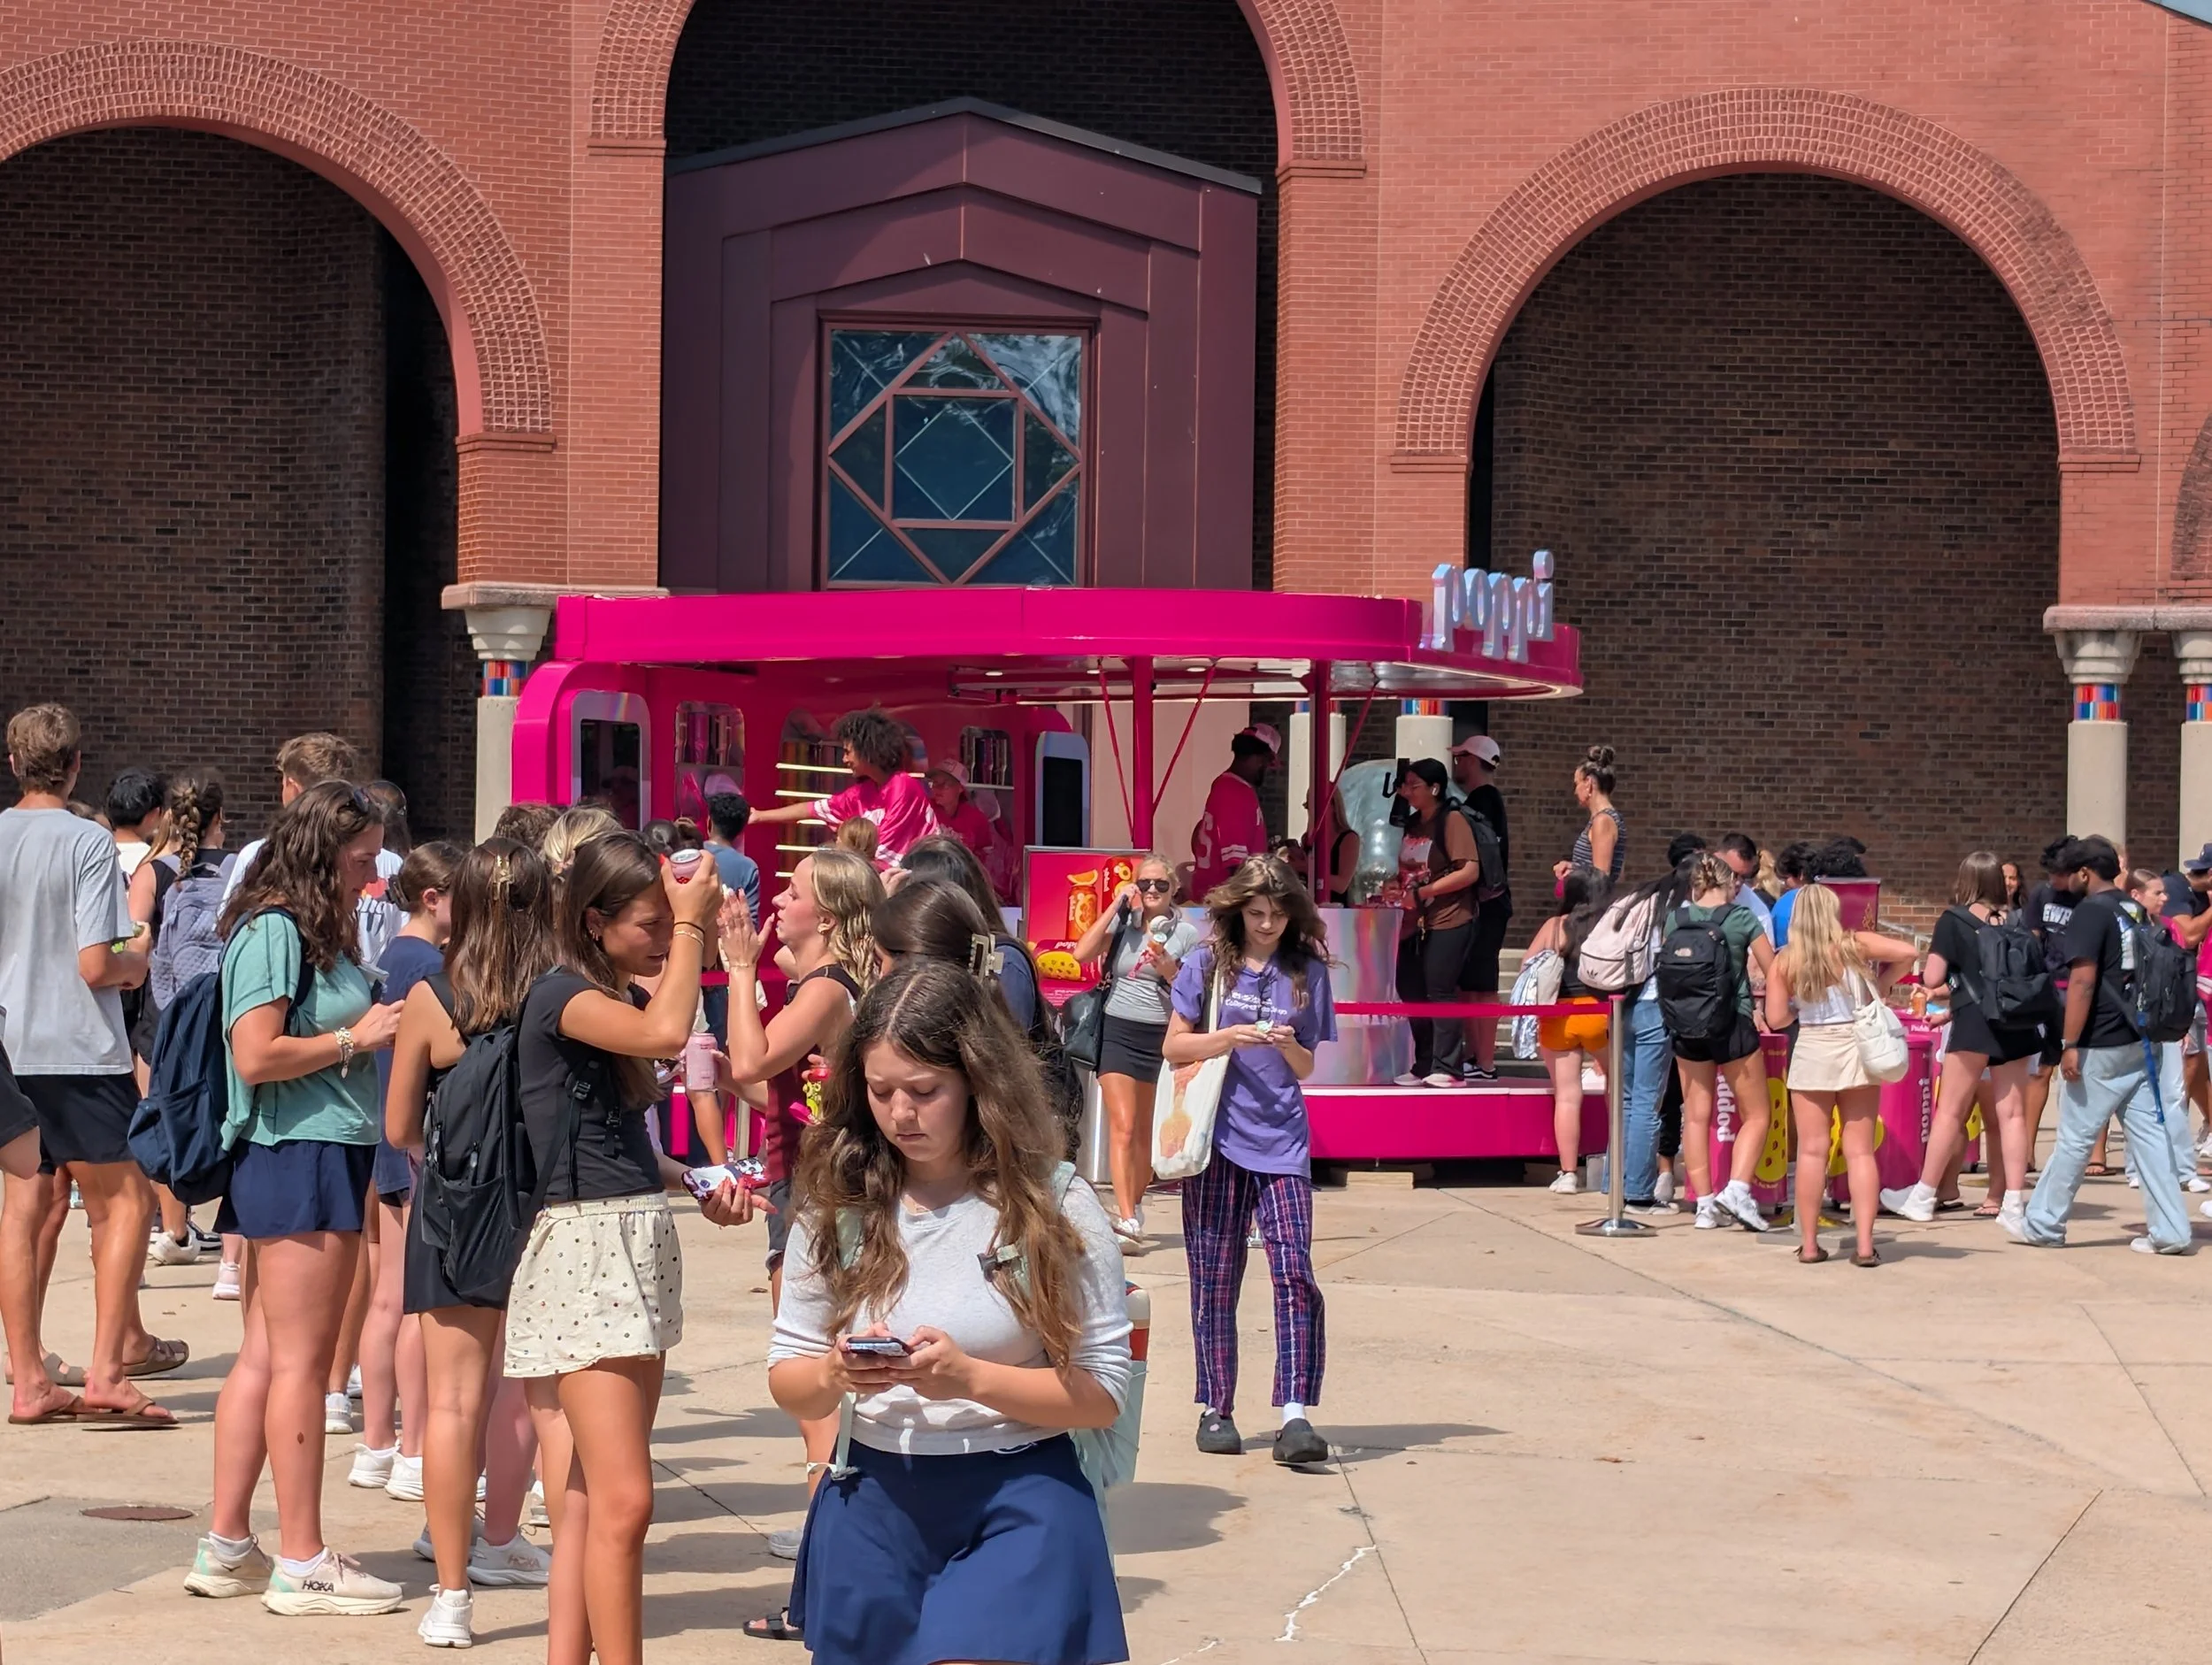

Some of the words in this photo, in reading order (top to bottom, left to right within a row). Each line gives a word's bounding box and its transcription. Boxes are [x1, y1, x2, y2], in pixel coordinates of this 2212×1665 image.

[1431, 549, 1555, 664] poppi
[1917, 1078, 1931, 1144] poppi
[302, 1580, 334, 1592] HOKA
